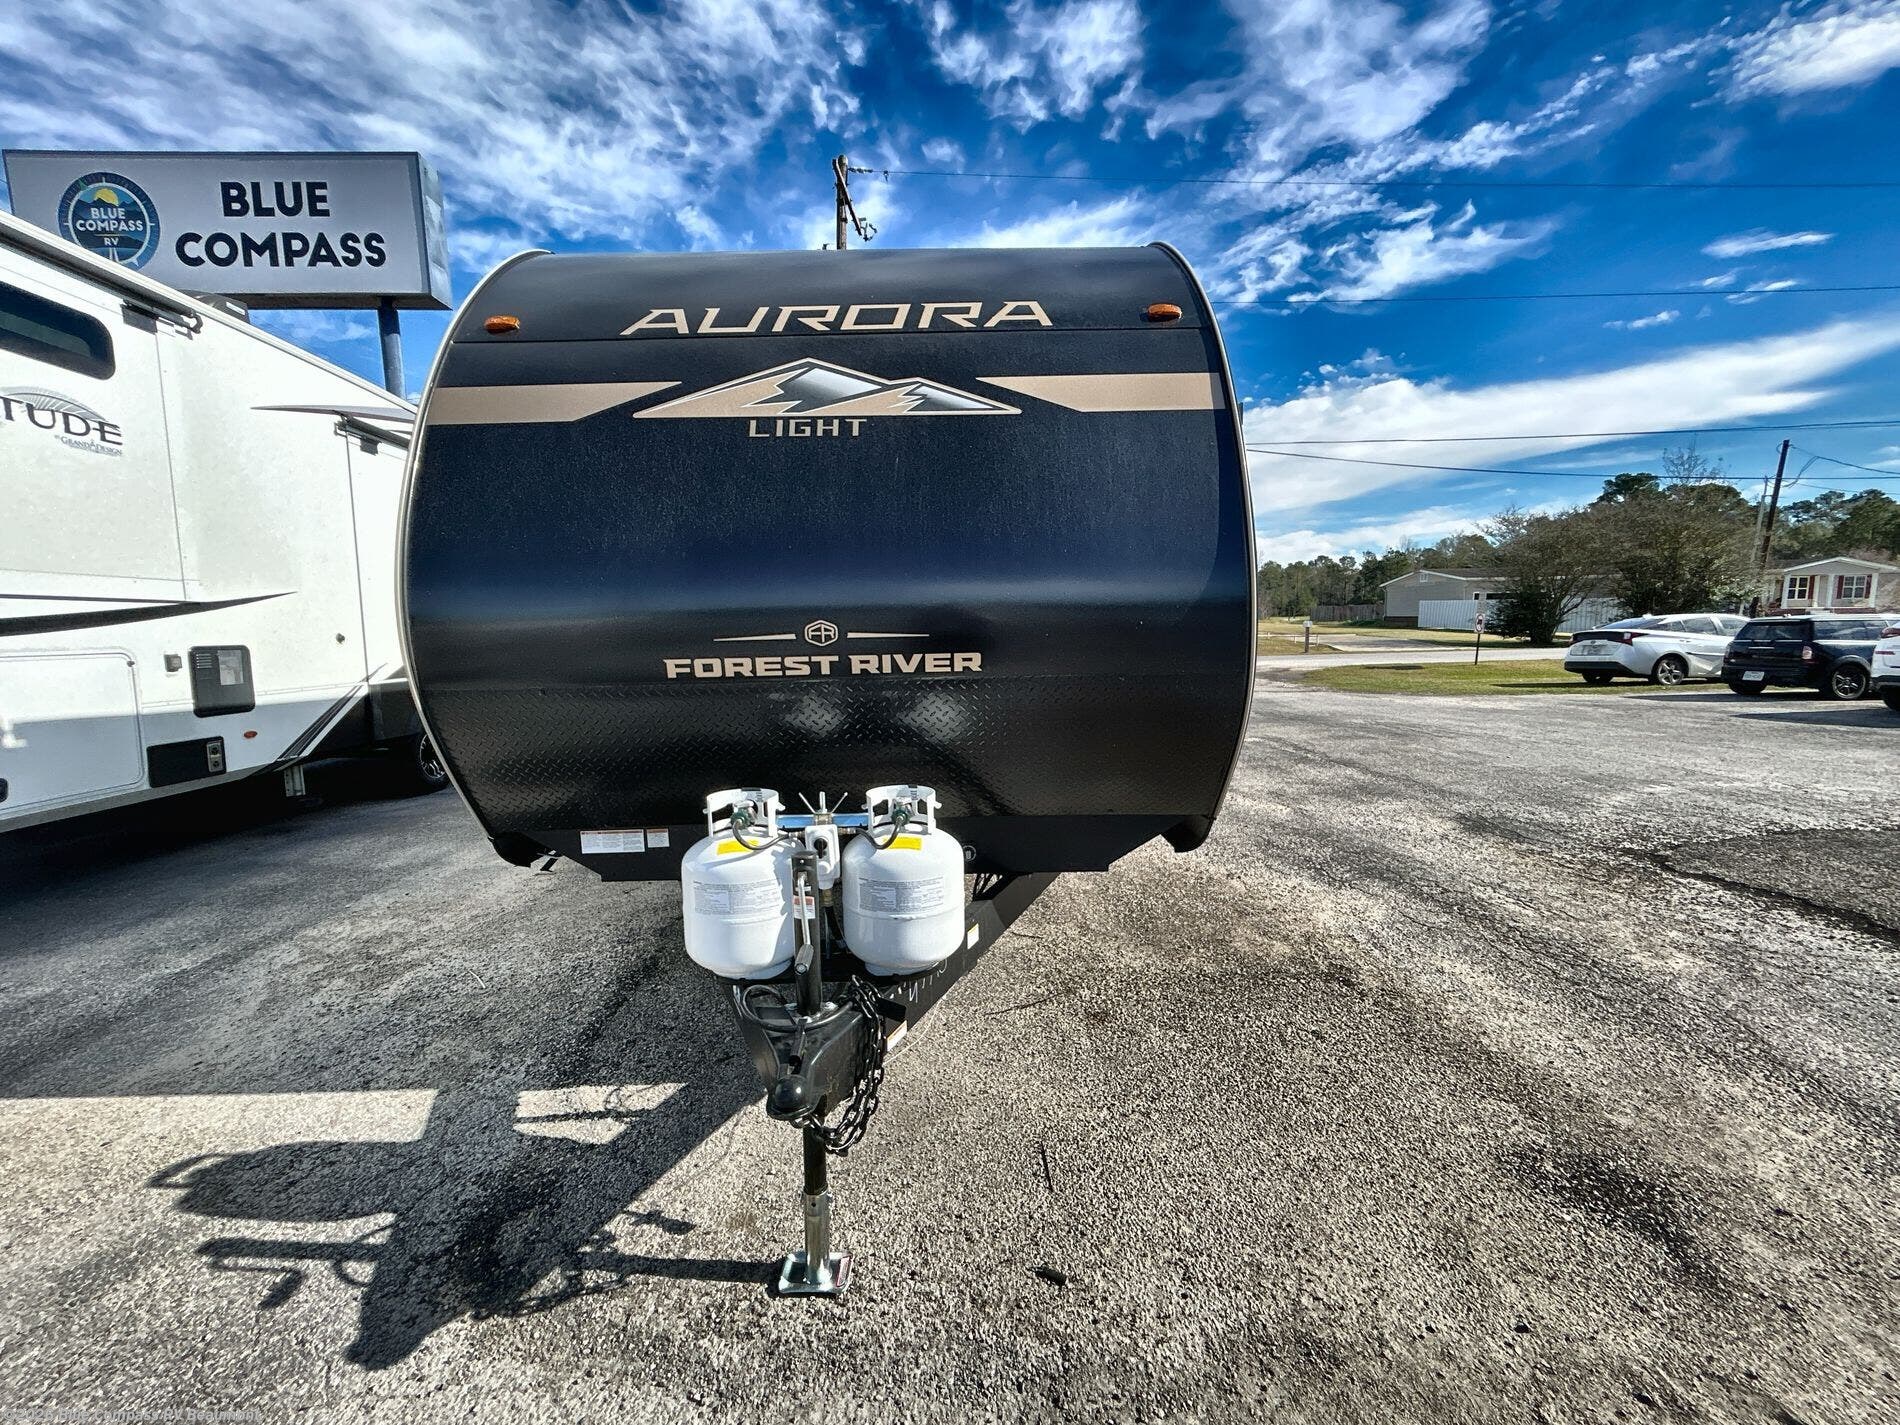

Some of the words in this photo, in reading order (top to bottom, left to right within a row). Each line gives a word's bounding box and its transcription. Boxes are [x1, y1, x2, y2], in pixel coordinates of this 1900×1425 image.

[219, 181, 331, 217] BLUE
[90, 207, 126, 219] BLUE
[75, 219, 144, 232] COMPASS
[103, 237, 119, 246] RV
[174, 231, 387, 268] COMPASS
[619, 300, 1054, 336] AURORA
[748, 418, 867, 438] LIGHT
[662, 655, 839, 679] FOREST
[848, 652, 983, 675] RIVER
